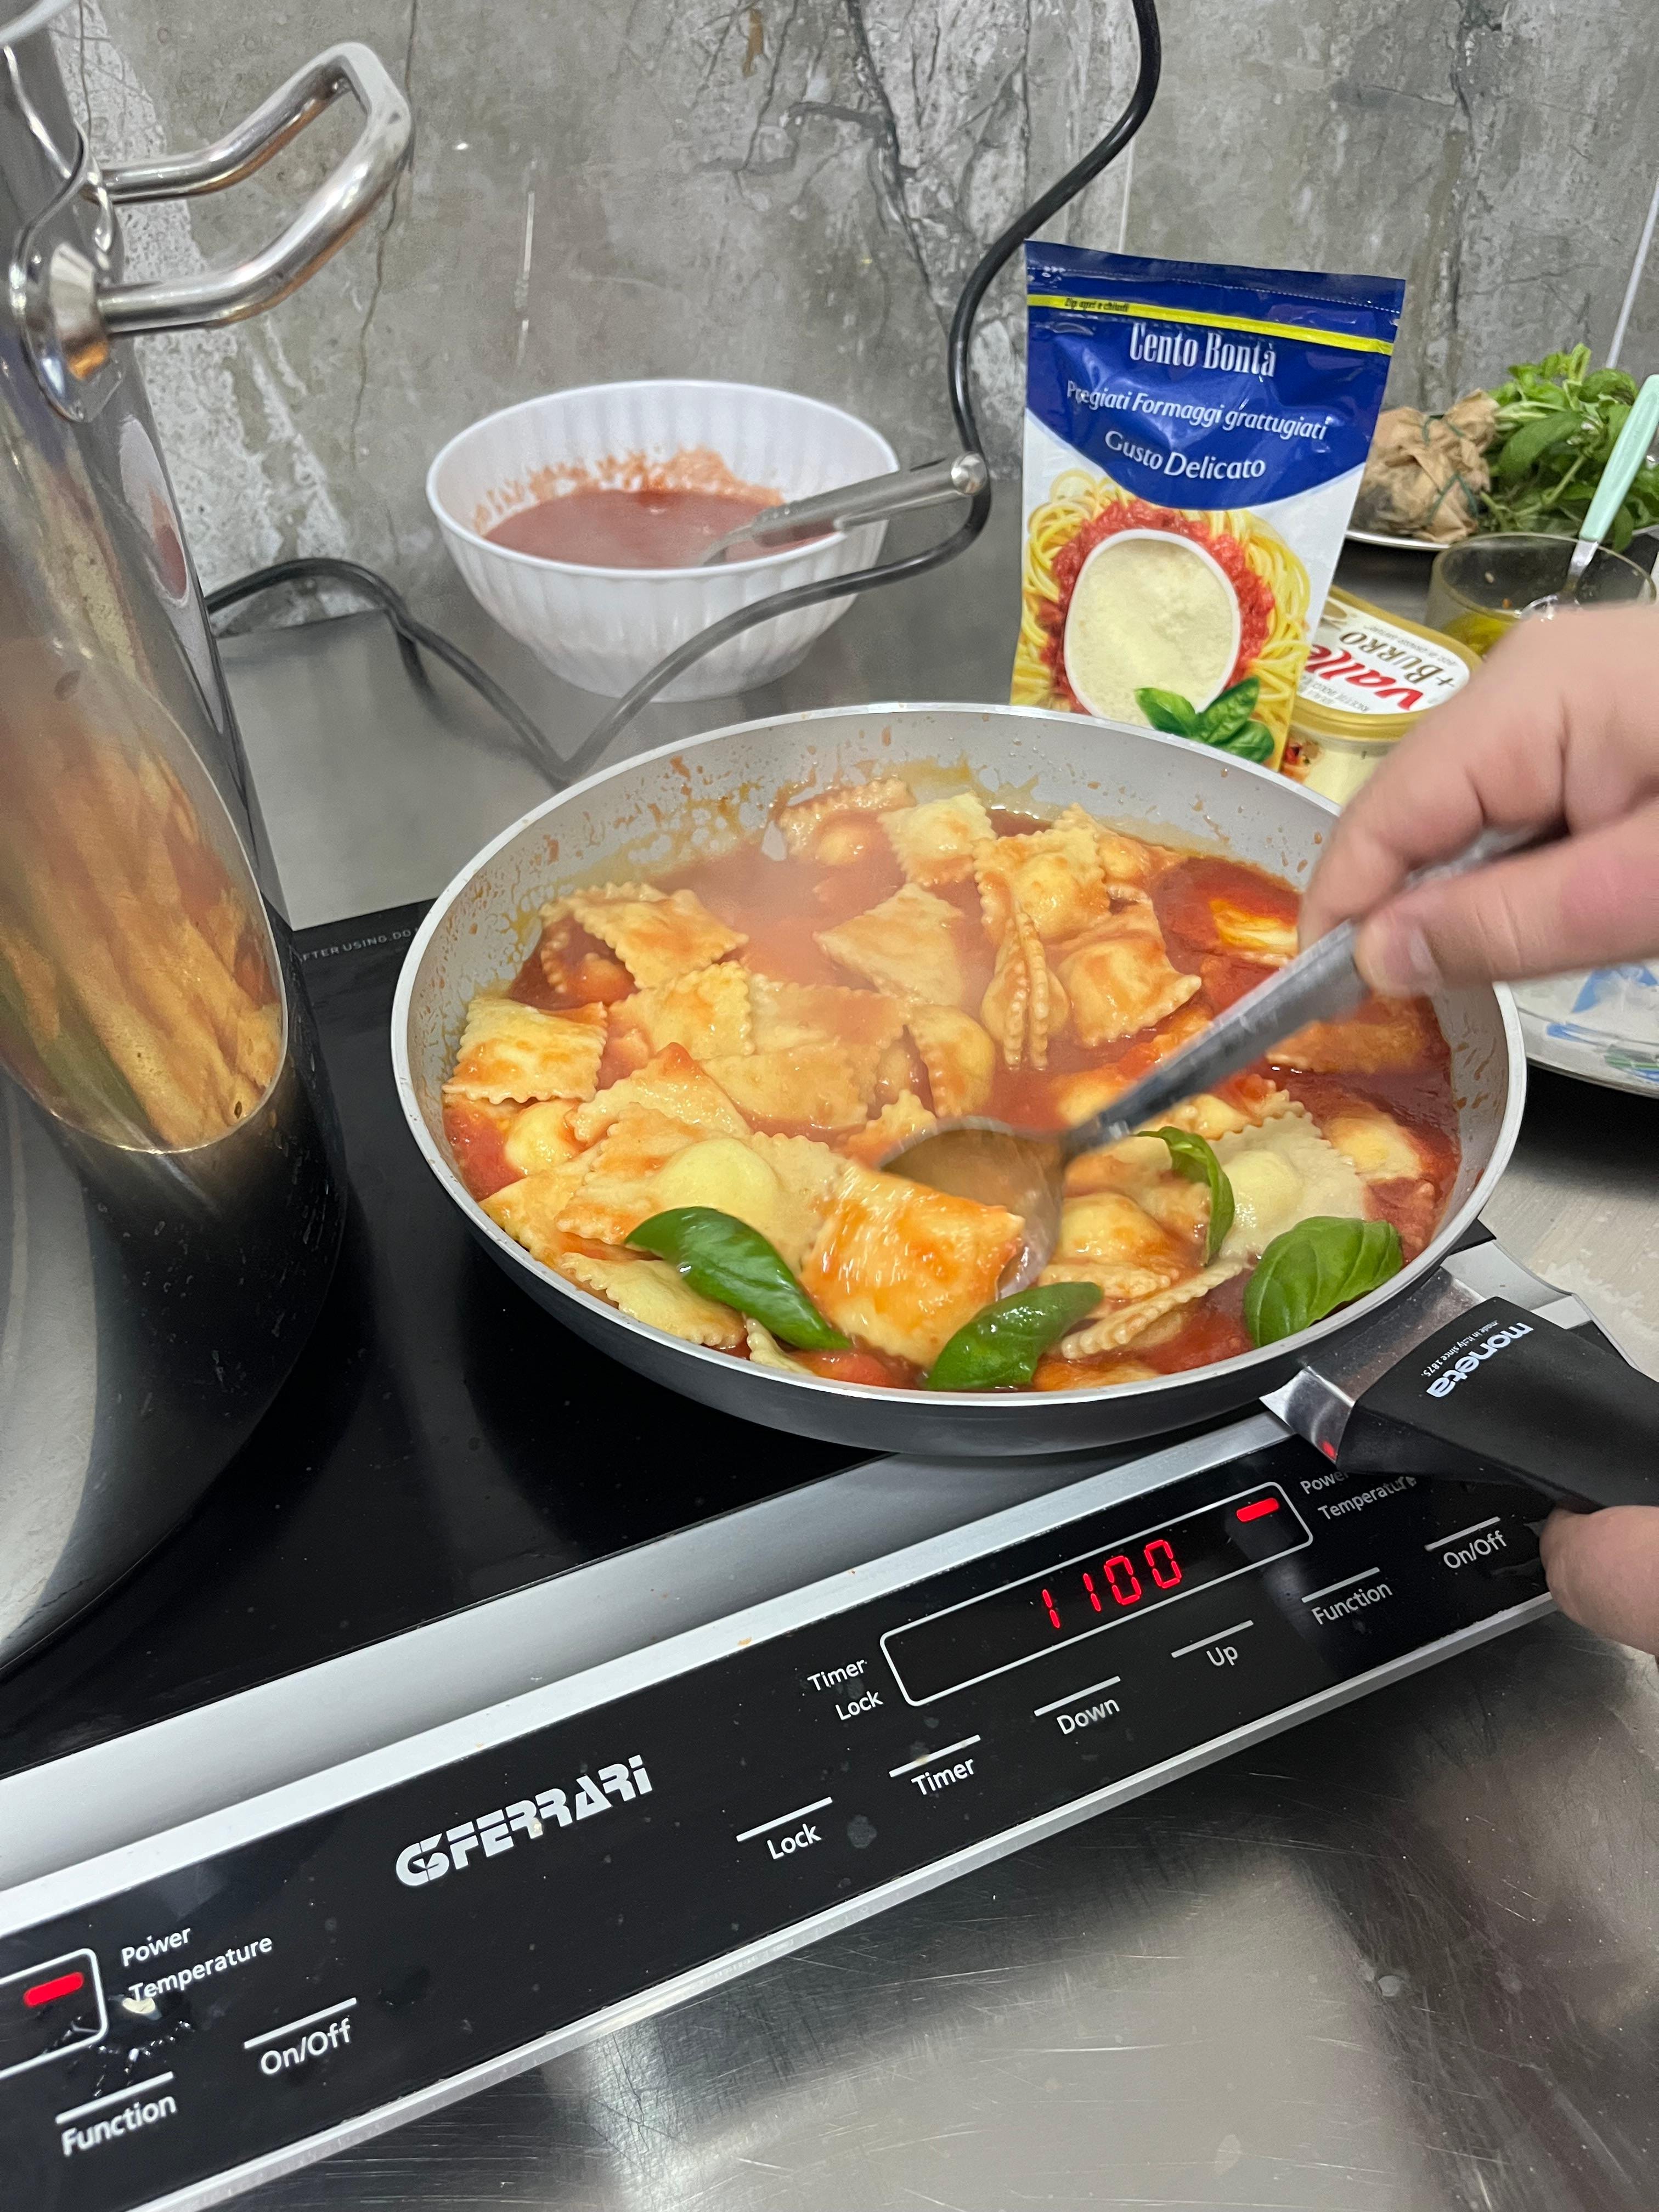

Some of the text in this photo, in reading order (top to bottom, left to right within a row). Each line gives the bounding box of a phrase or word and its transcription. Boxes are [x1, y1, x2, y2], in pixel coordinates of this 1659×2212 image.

[1130, 323, 1277, 377] Cento Bontà
[1067, 380, 1328, 441] Pregiati Formaggi grattugiati
[1105, 431, 1267, 481] Gusto Delicato
[1426, 1322, 1534, 1397] moneta
[1441, 1344, 1460, 1361] since
[1443, 1530, 1508, 1570] On/Off
[1042, 1539, 1182, 1628] 1100
[1311, 1583, 1393, 1626] Function
[807, 1658, 866, 1691] Timer
[1206, 1646, 1238, 1667] Up
[836, 1690, 883, 1721] Lock
[1057, 1699, 1120, 1735] Down
[911, 1758, 975, 1796] Timer
[768, 1824, 822, 1860] Lock
[121, 1928, 191, 1967] Power
[128, 1937, 273, 2002] Temperature
[260, 2018, 352, 2075] On/Off
[61, 2095, 178, 2157] Function
